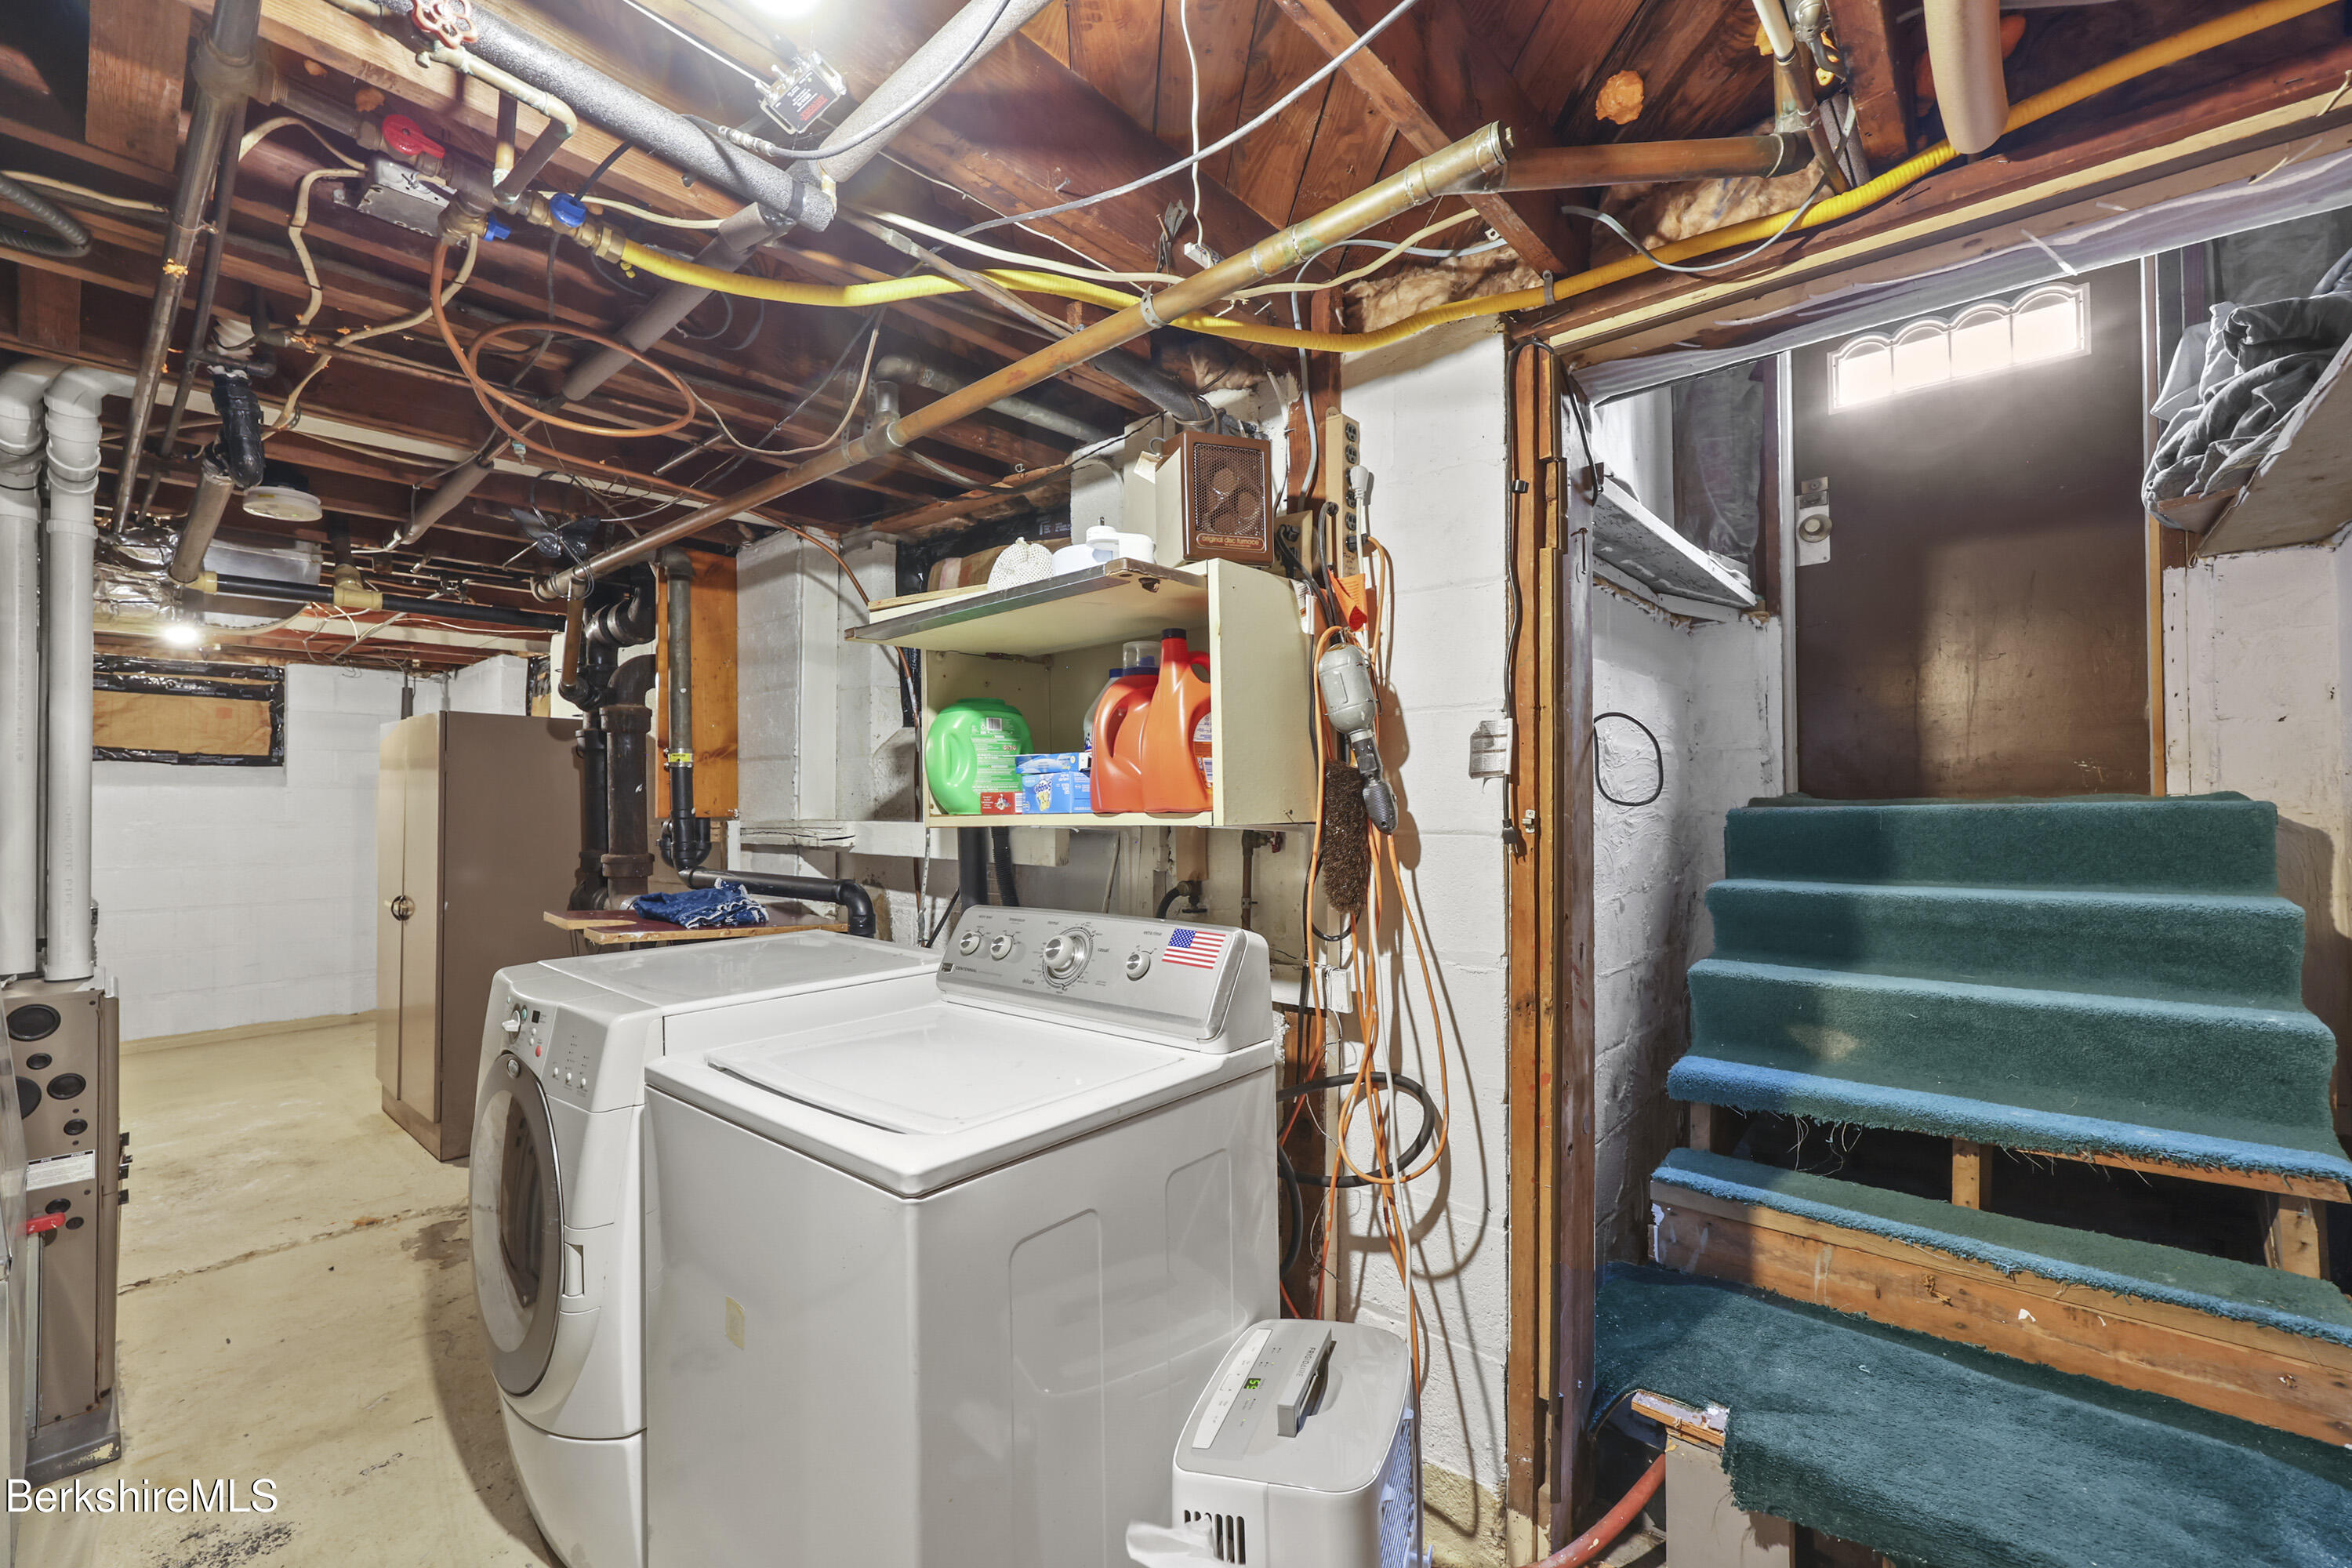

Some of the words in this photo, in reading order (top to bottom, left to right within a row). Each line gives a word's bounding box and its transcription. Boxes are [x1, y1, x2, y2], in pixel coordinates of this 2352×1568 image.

[64, 806, 75, 872] CHARLOTTE
[64, 877, 75, 907] PIPE
[1296, 1347, 1316, 1377] FRIGIDAIRE
